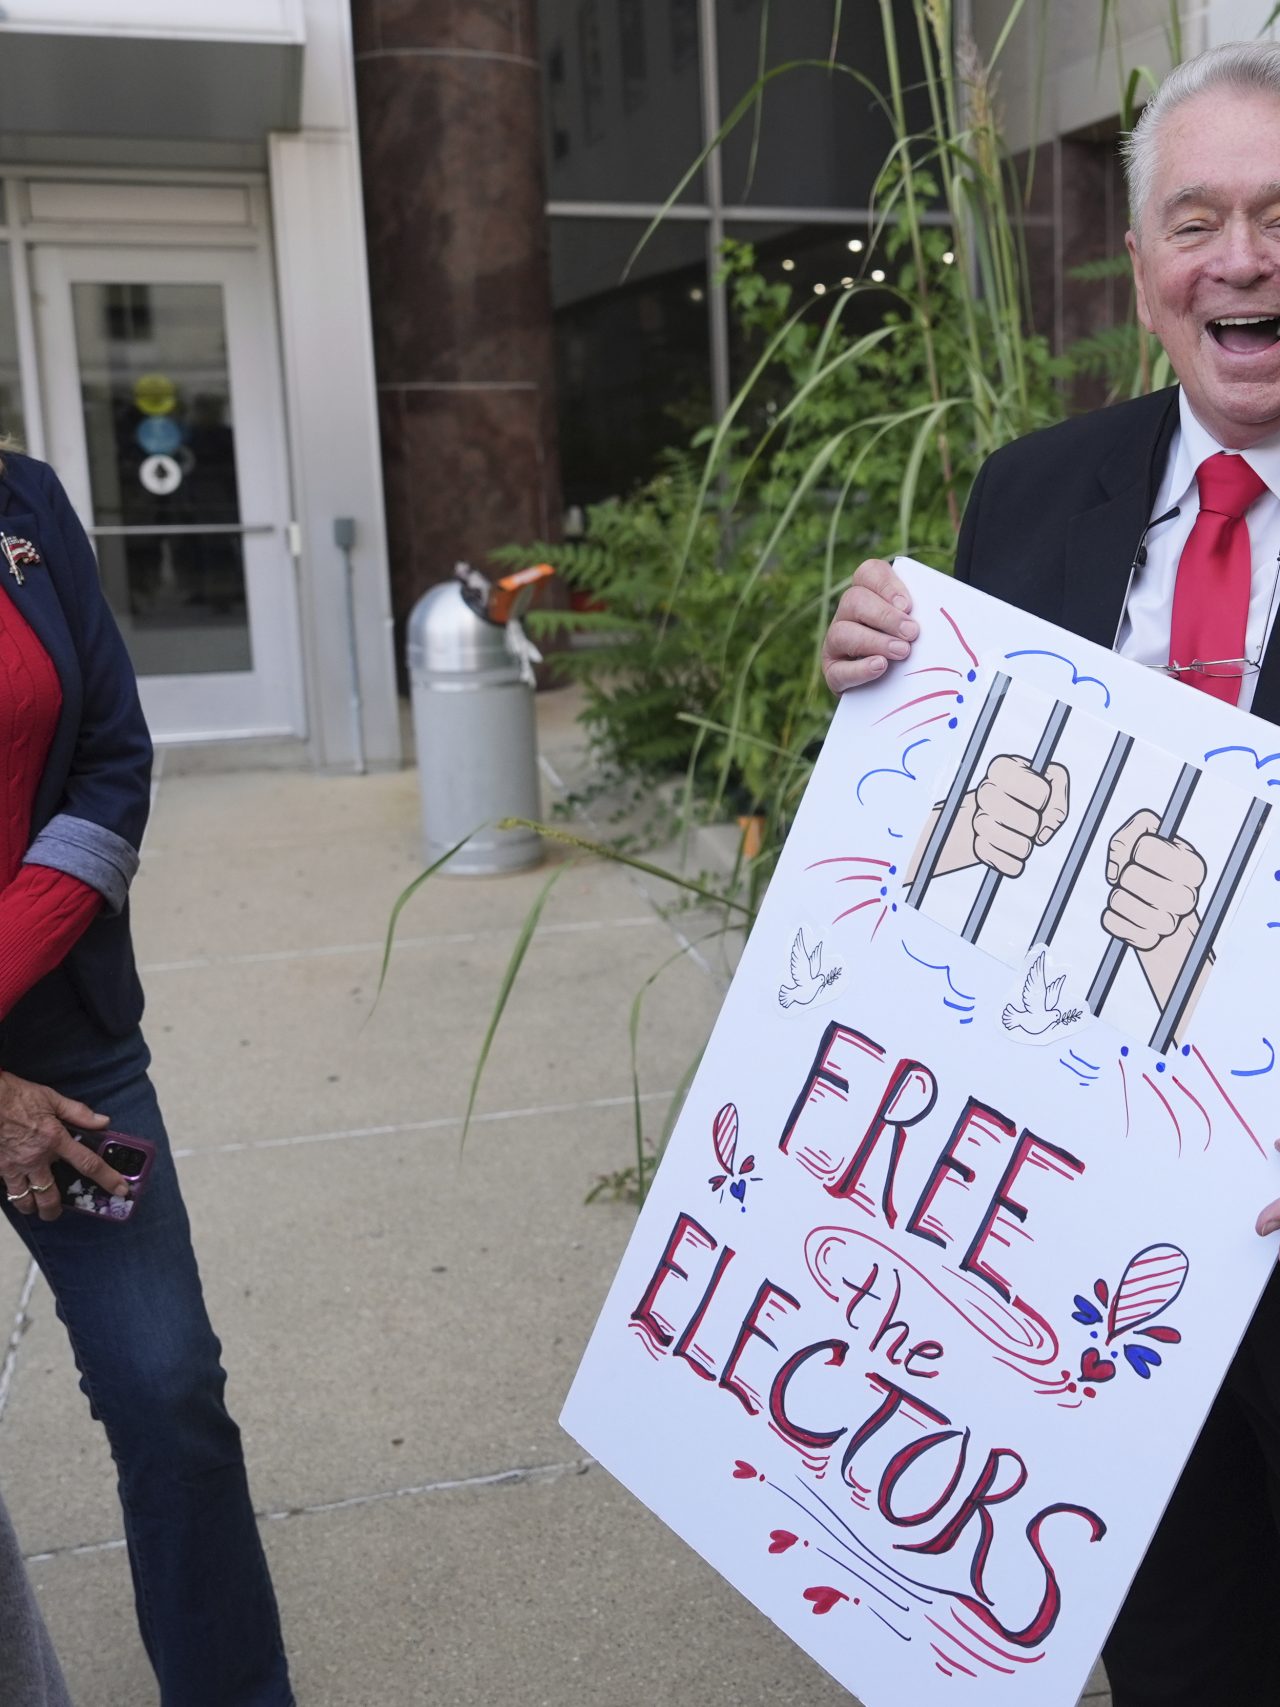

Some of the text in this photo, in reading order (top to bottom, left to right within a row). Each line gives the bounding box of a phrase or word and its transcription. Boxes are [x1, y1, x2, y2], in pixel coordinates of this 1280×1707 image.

[778, 1020, 1086, 1304] FREE
[631, 1211, 1107, 1648] ELECTORS
[841, 1262, 945, 1379] the
